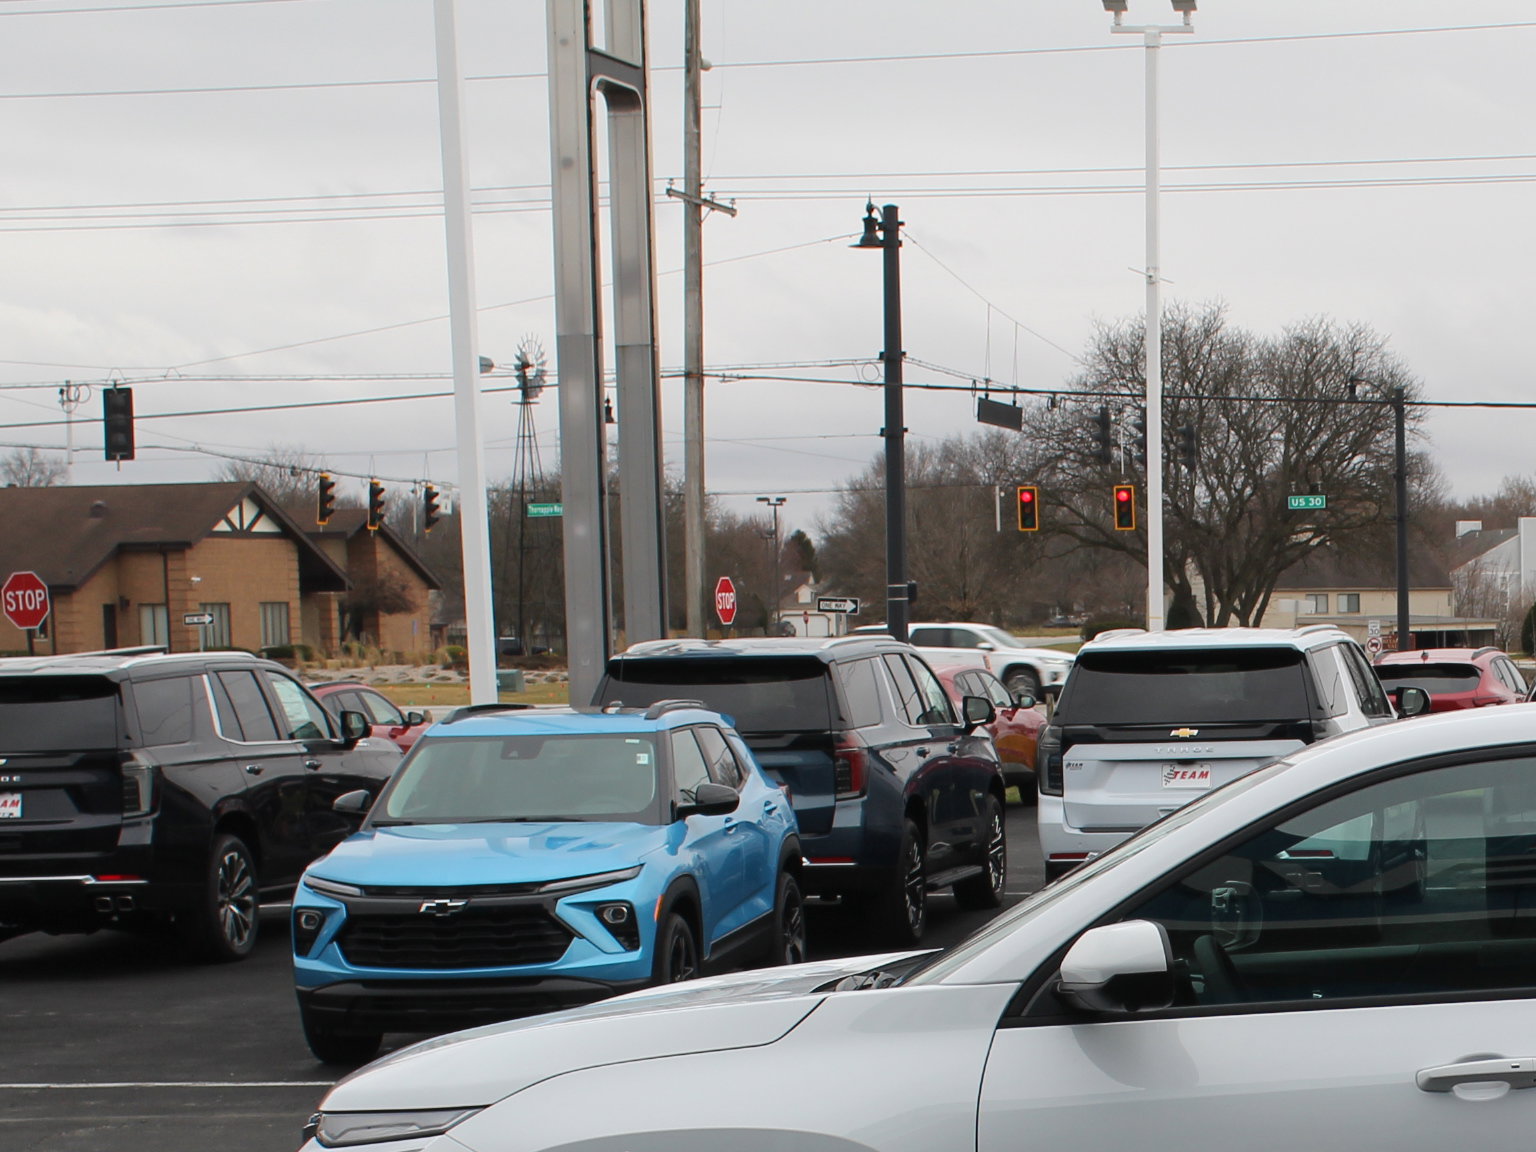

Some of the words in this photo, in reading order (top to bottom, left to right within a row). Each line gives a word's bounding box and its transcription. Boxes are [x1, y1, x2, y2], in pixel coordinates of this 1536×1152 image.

[1291, 497, 1305, 507] US
[1309, 497, 1322, 506] 30
[6, 589, 45, 612] STOP
[717, 592, 735, 610] STOP
[1154, 746, 1214, 754] TAHOE
[1172, 770, 1209, 780] TEAM
[0, 799, 20, 808] AM
